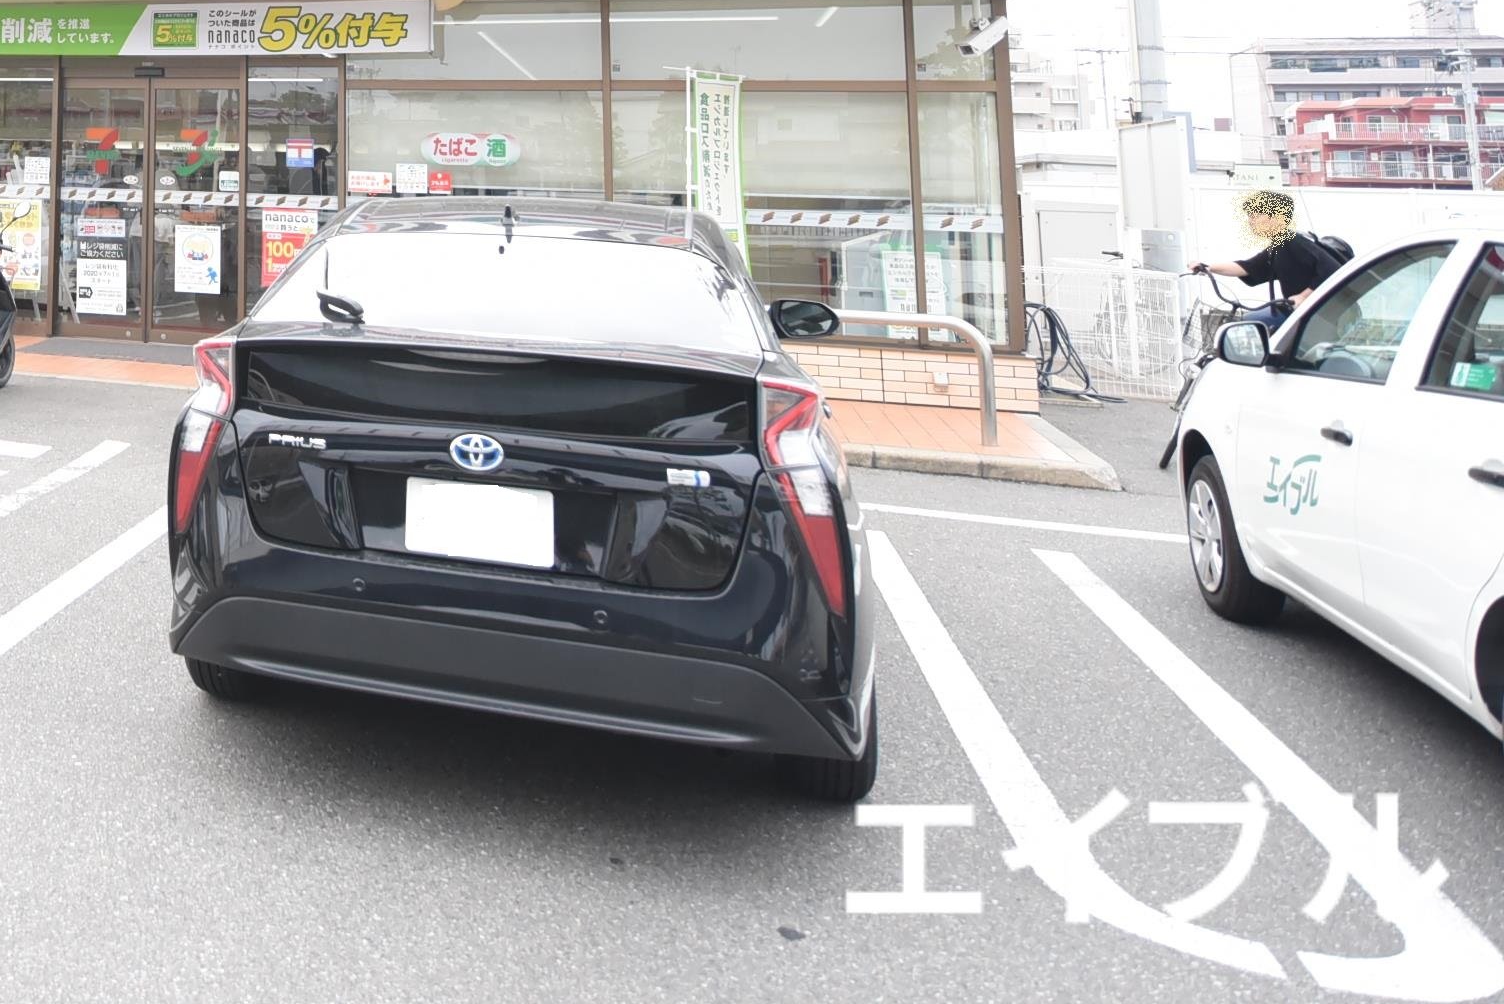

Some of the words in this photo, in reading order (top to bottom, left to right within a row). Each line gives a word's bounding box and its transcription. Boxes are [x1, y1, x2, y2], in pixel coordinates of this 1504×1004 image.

[208, 9, 257, 18] このシールが
[57, 18, 91, 30] を推進
[207, 19, 256, 27] ついた商品は
[258, 5, 409, 52] 5%付与
[208, 29, 256, 44] nanaco
[434, 137, 478, 156] たばこ
[486, 138, 506, 157] 酒
[268, 433, 327, 450] PRIUS
